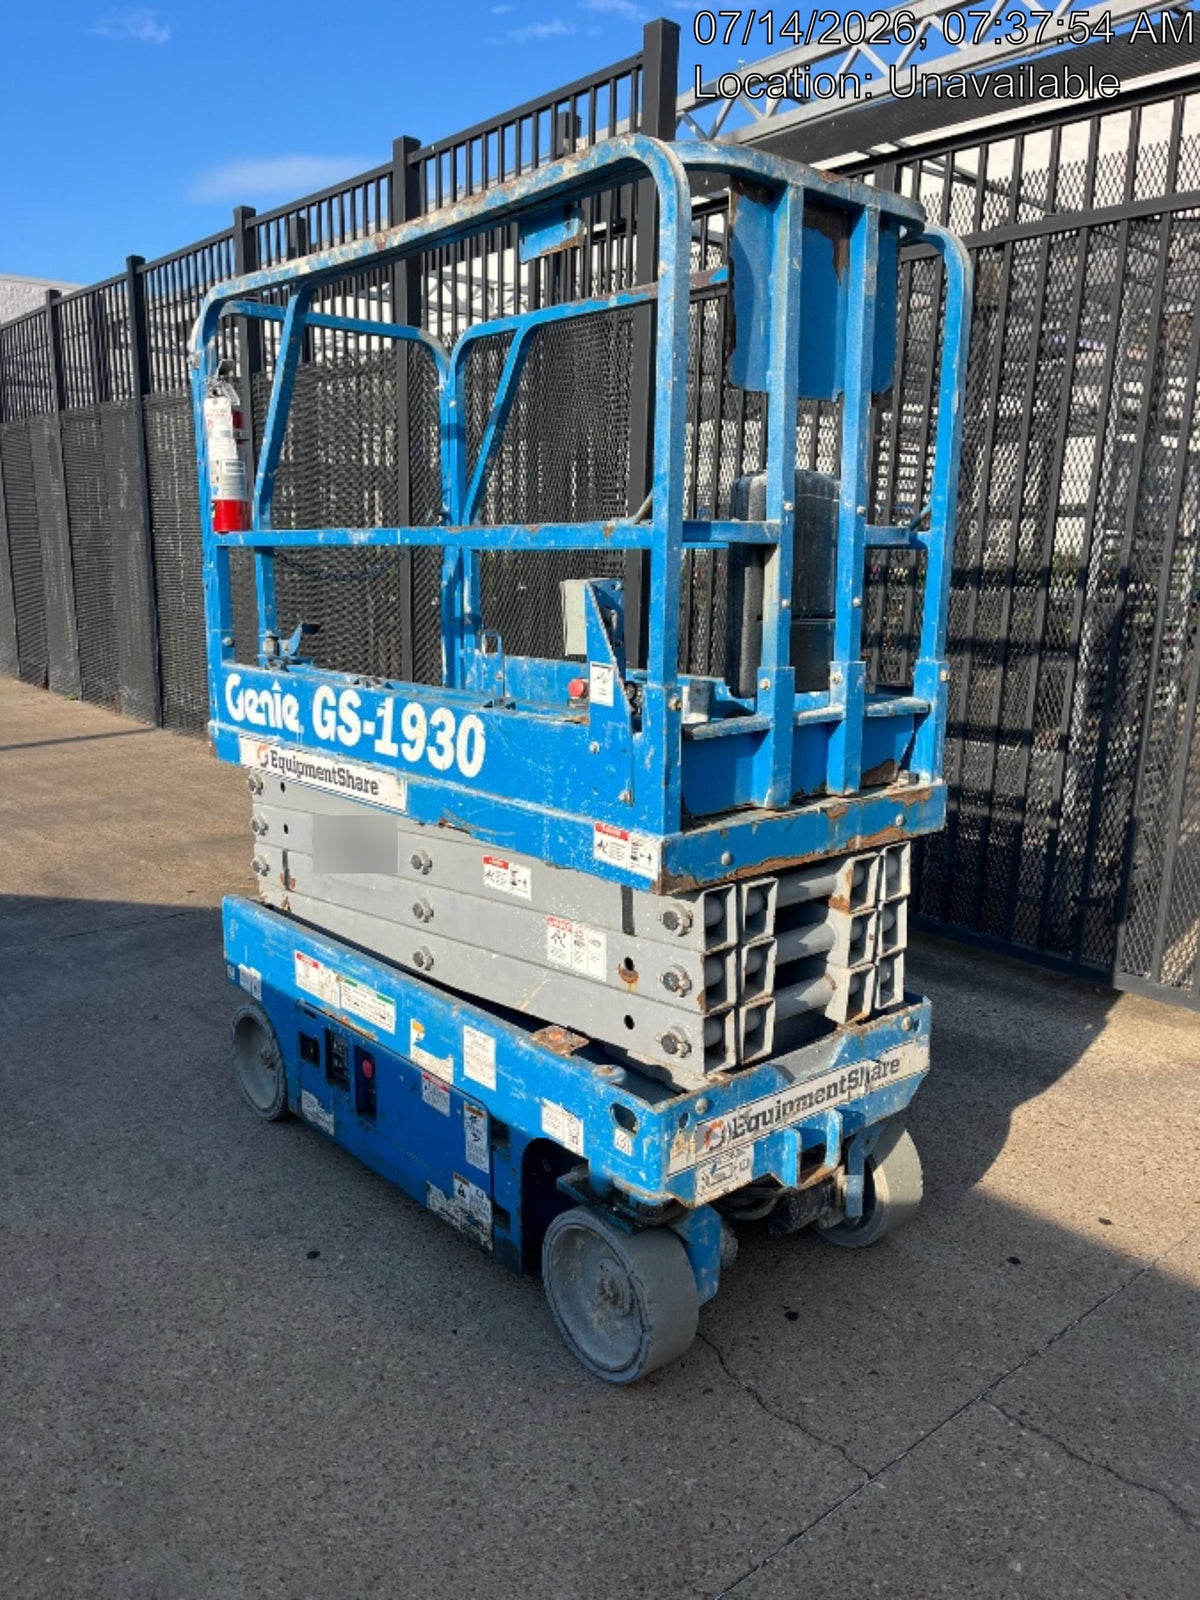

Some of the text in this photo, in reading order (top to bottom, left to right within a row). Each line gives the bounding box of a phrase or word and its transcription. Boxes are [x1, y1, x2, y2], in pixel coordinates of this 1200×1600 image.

[225, 673, 486, 778] Genie GS-1930
[269, 750, 380, 796] EquipmentShare
